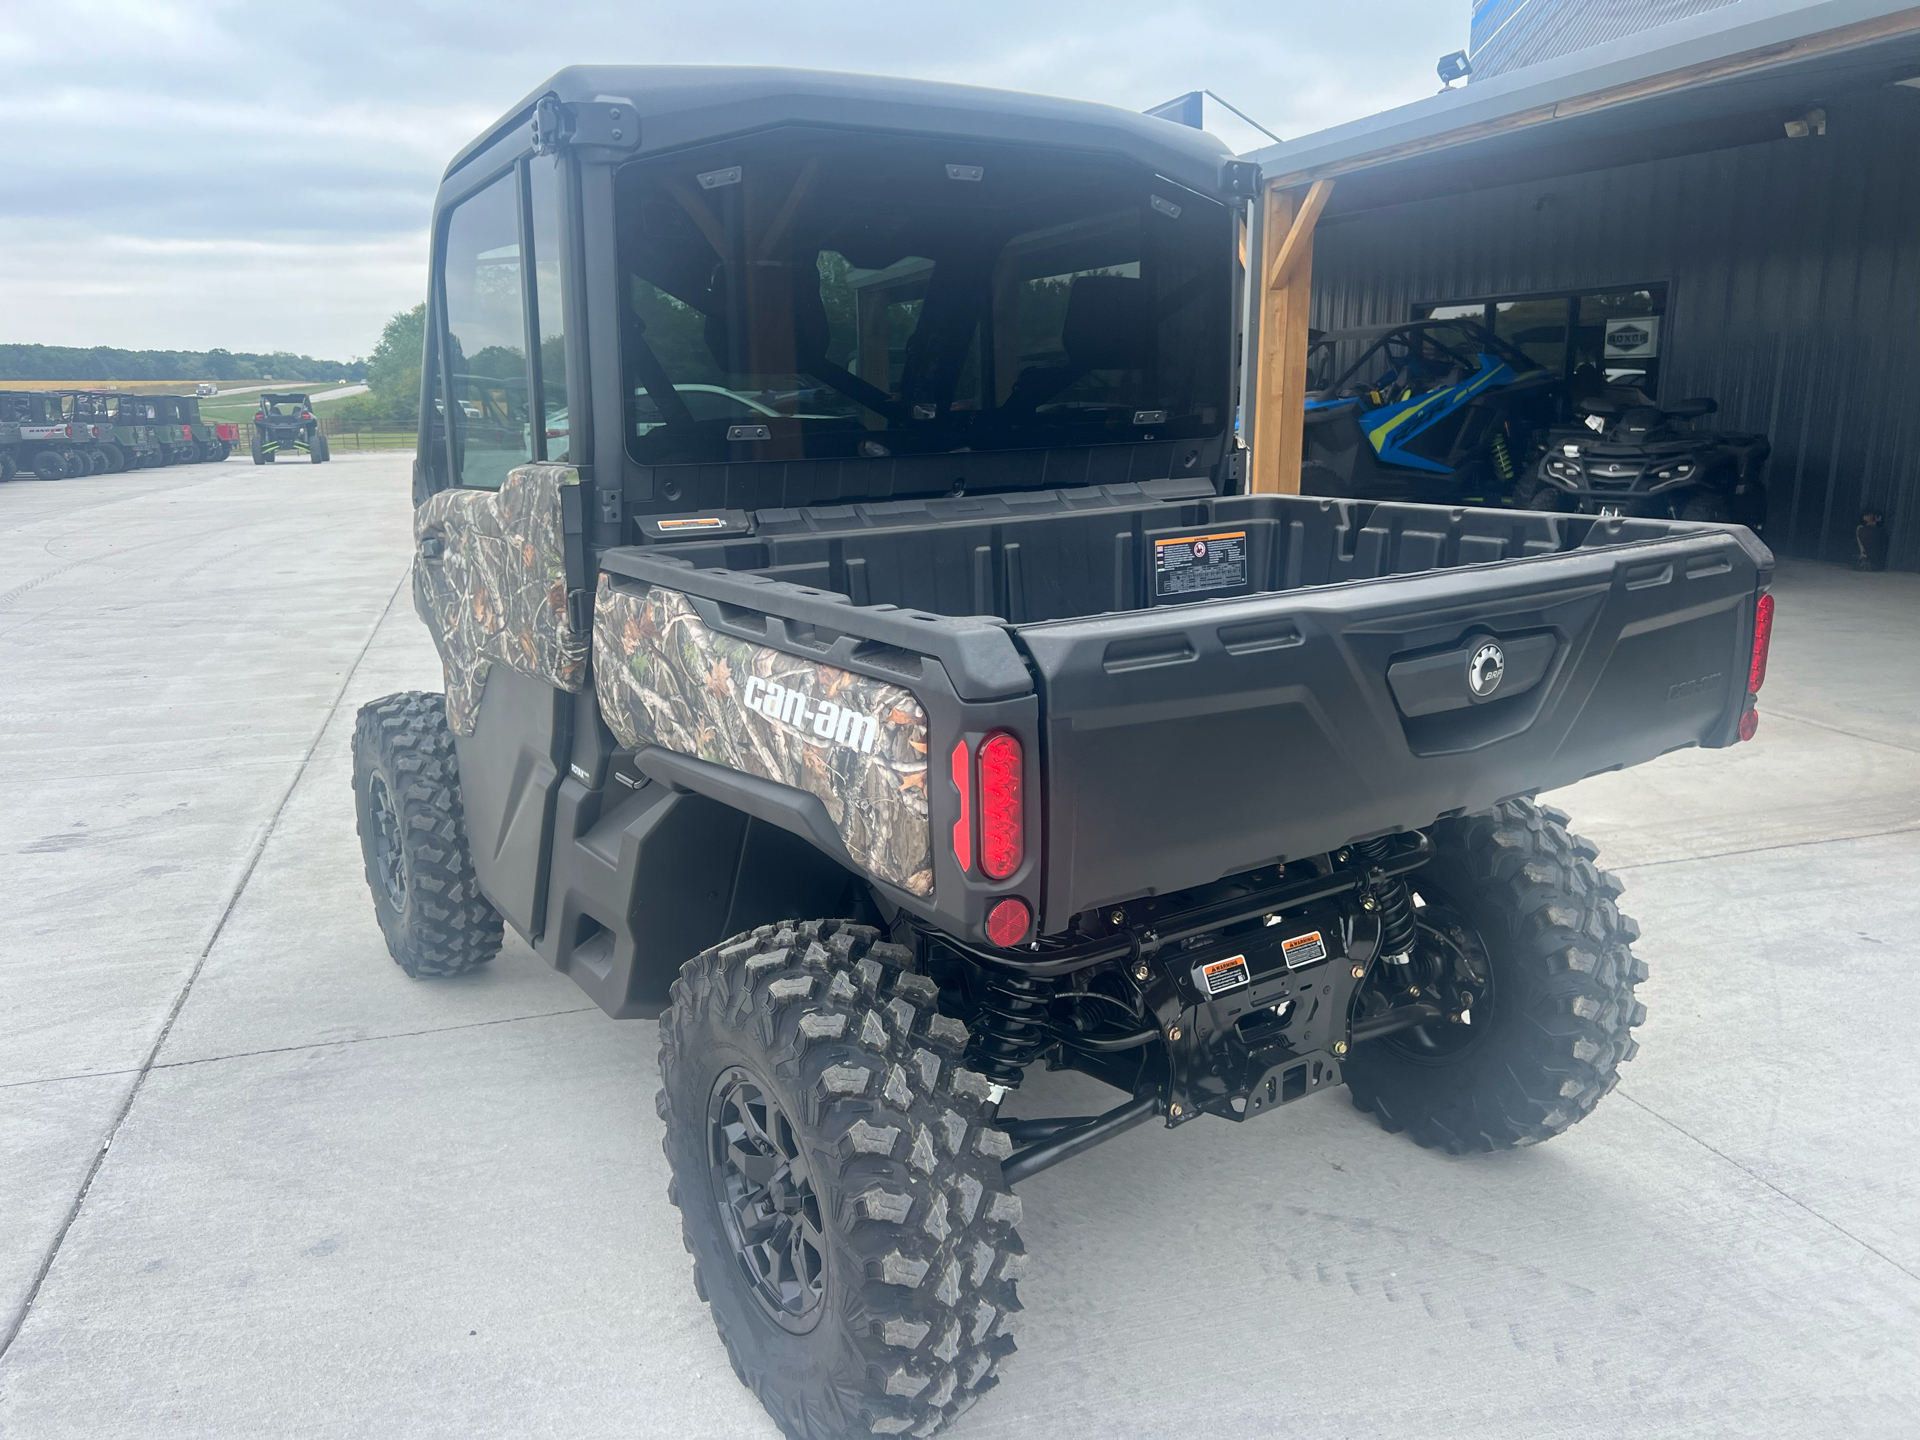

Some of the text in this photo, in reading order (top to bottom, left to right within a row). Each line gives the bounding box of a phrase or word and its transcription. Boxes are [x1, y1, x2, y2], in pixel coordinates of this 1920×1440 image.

[1485, 668, 1503, 681] BRP
[743, 674, 877, 755] can-am
[1293, 936, 1315, 946] WARNING
[1215, 960, 1238, 971] WARNING
